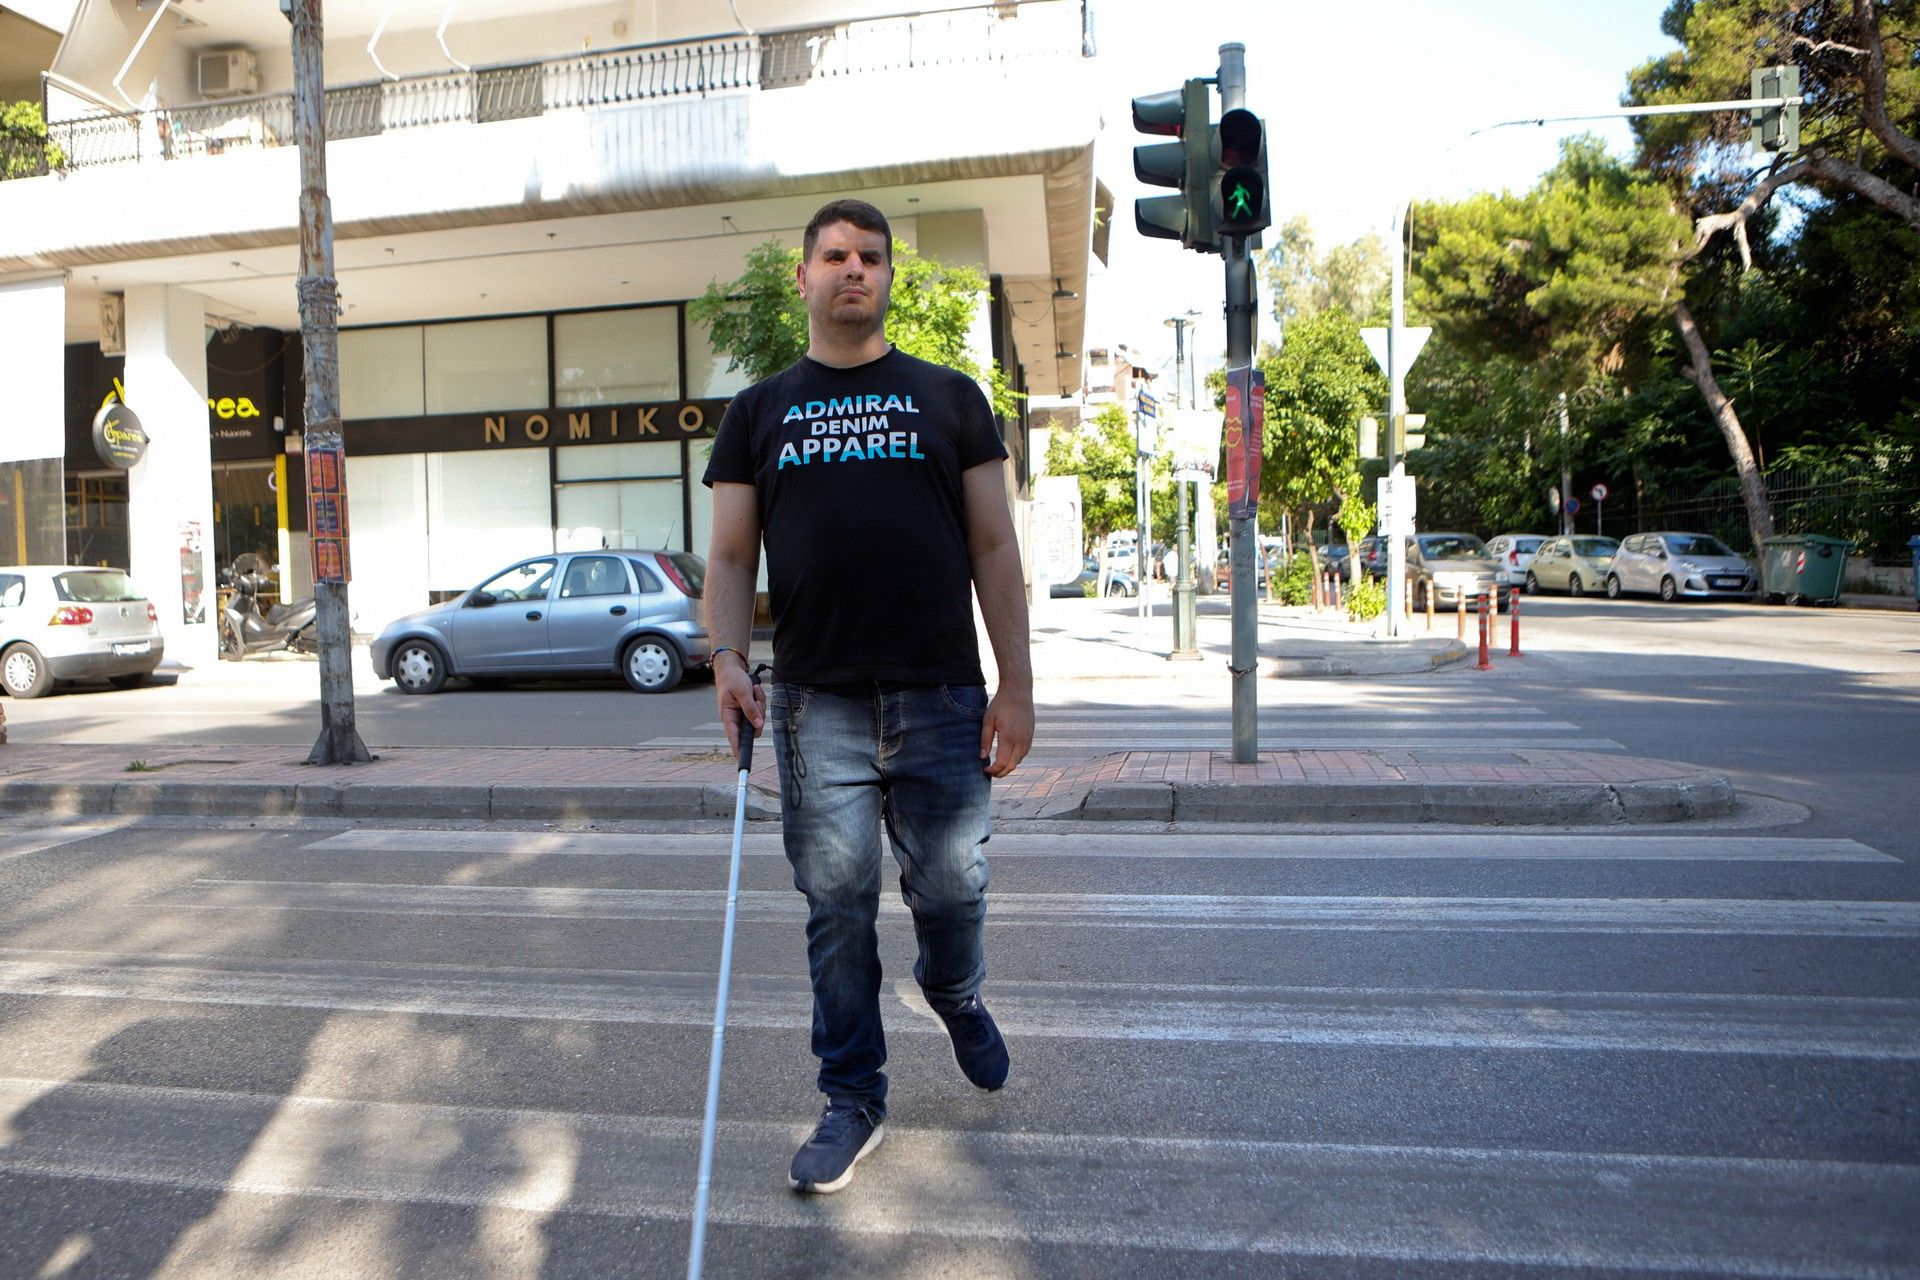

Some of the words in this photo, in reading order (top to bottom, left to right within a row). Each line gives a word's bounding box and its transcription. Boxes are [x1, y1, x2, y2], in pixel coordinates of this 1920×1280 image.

[484, 403, 728, 443] NOMIKO
[782, 394, 920, 425] ADMIRAL
[811, 414, 889, 436] DENIM
[777, 431, 925, 471] APPAREL
